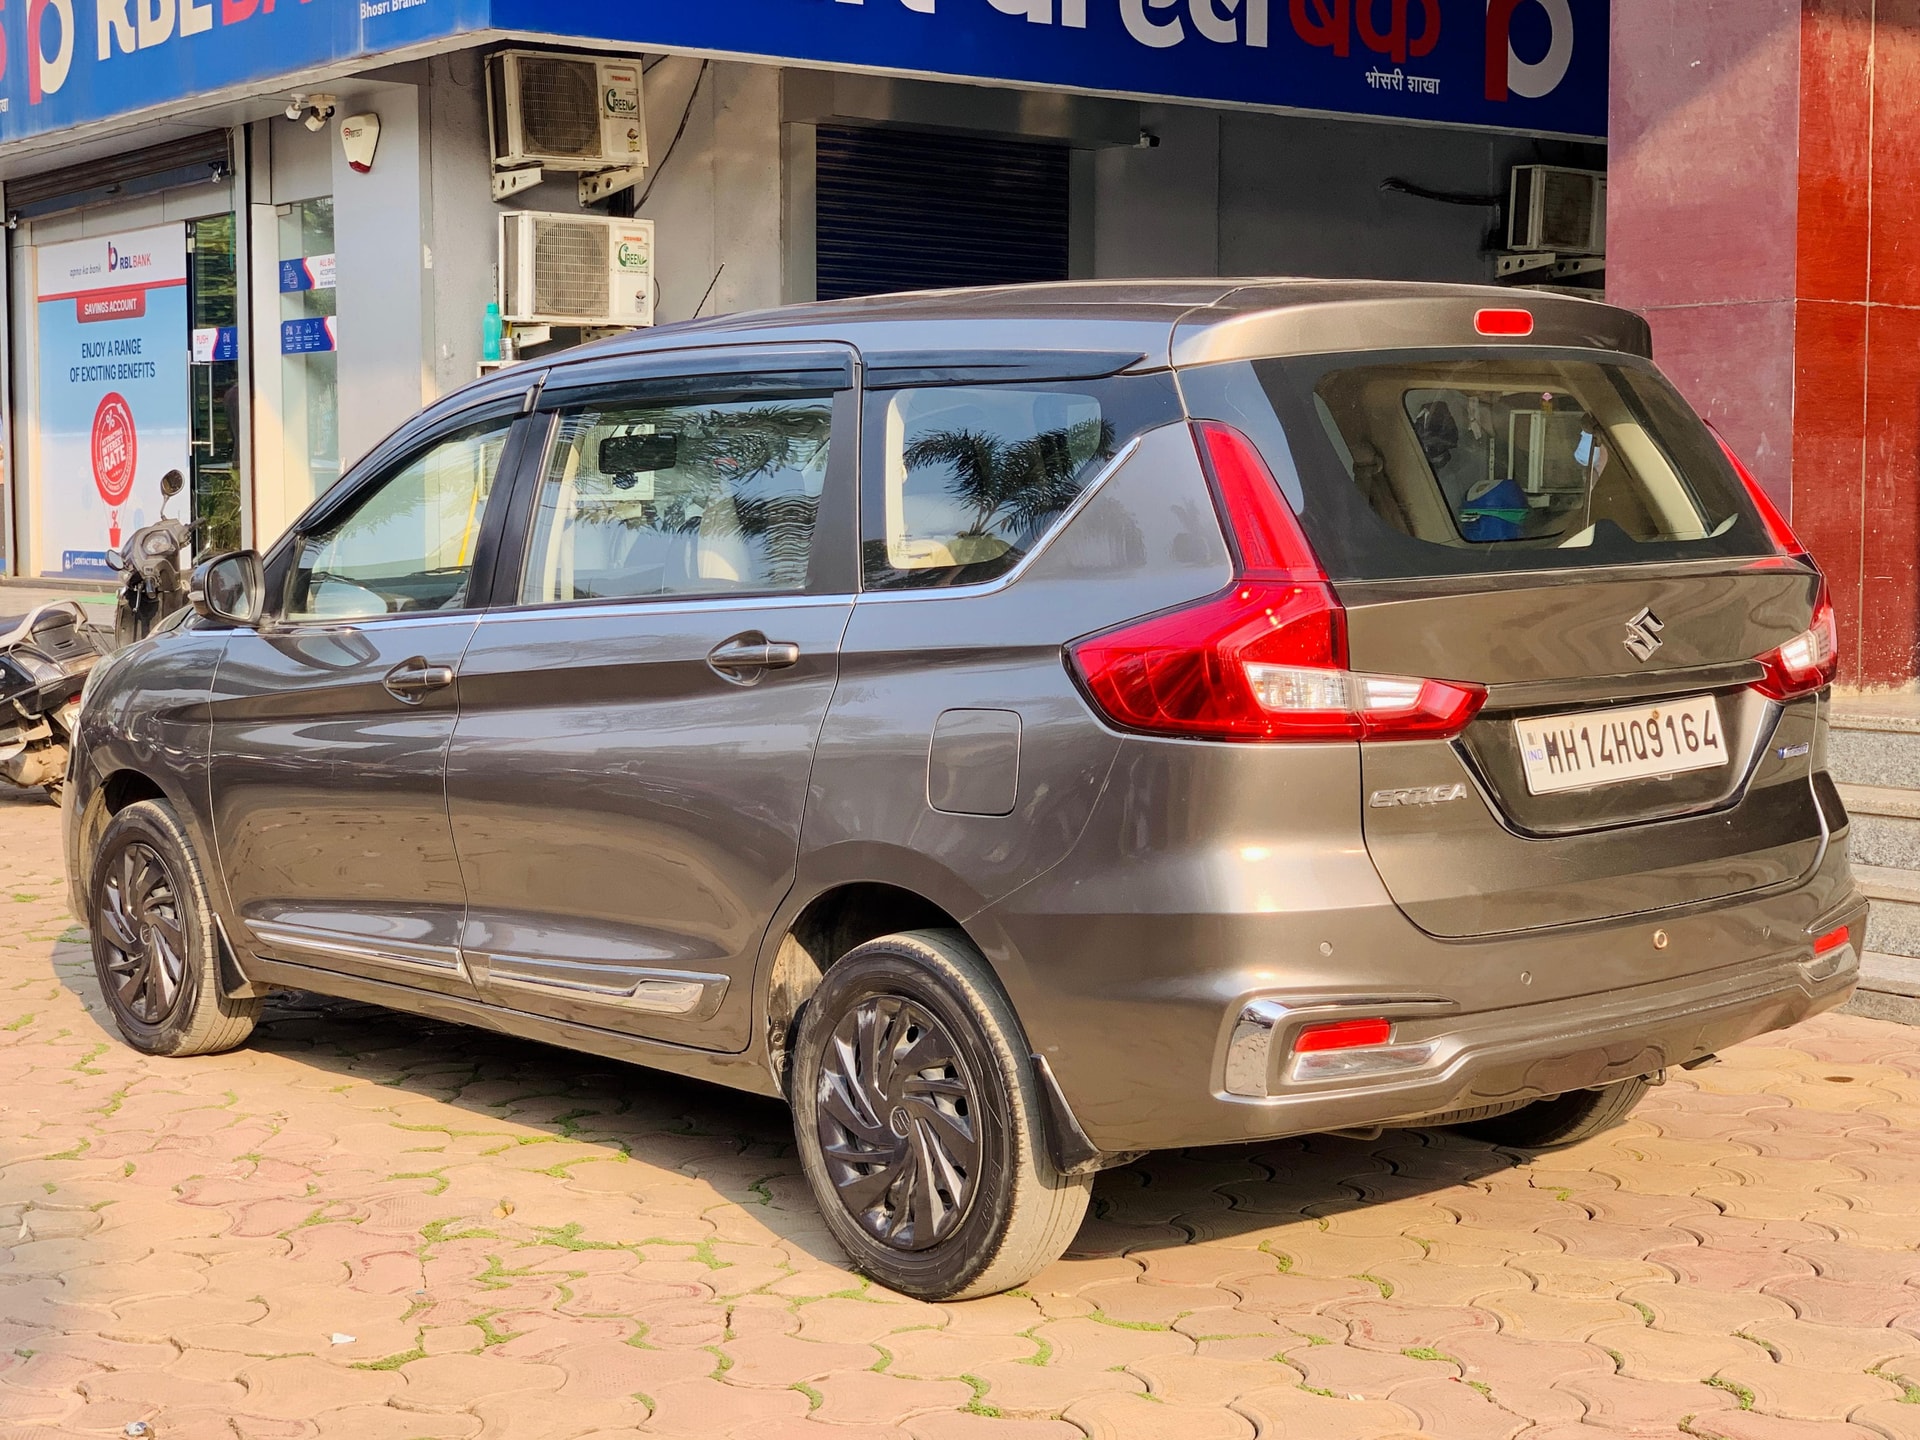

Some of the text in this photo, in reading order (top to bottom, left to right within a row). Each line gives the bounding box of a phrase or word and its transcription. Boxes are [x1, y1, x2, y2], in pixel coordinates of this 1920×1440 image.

[391, 0, 428, 11] Branc
[1365, 66, 1440, 95] भोसरी शाखा
[120, 253, 152, 270] RBL BANK
[84, 298, 138, 315] SAVINGS ACCOUNT
[82, 338, 142, 359] ENJOY A RANGE
[70, 361, 156, 383] OF EXCITING BENEFITS
[103, 444, 127, 473] RATE
[1543, 709, 1719, 774] MH14HQ9164
[1528, 748, 1544, 761] IND
[1368, 783, 1468, 809] ERTIGA
